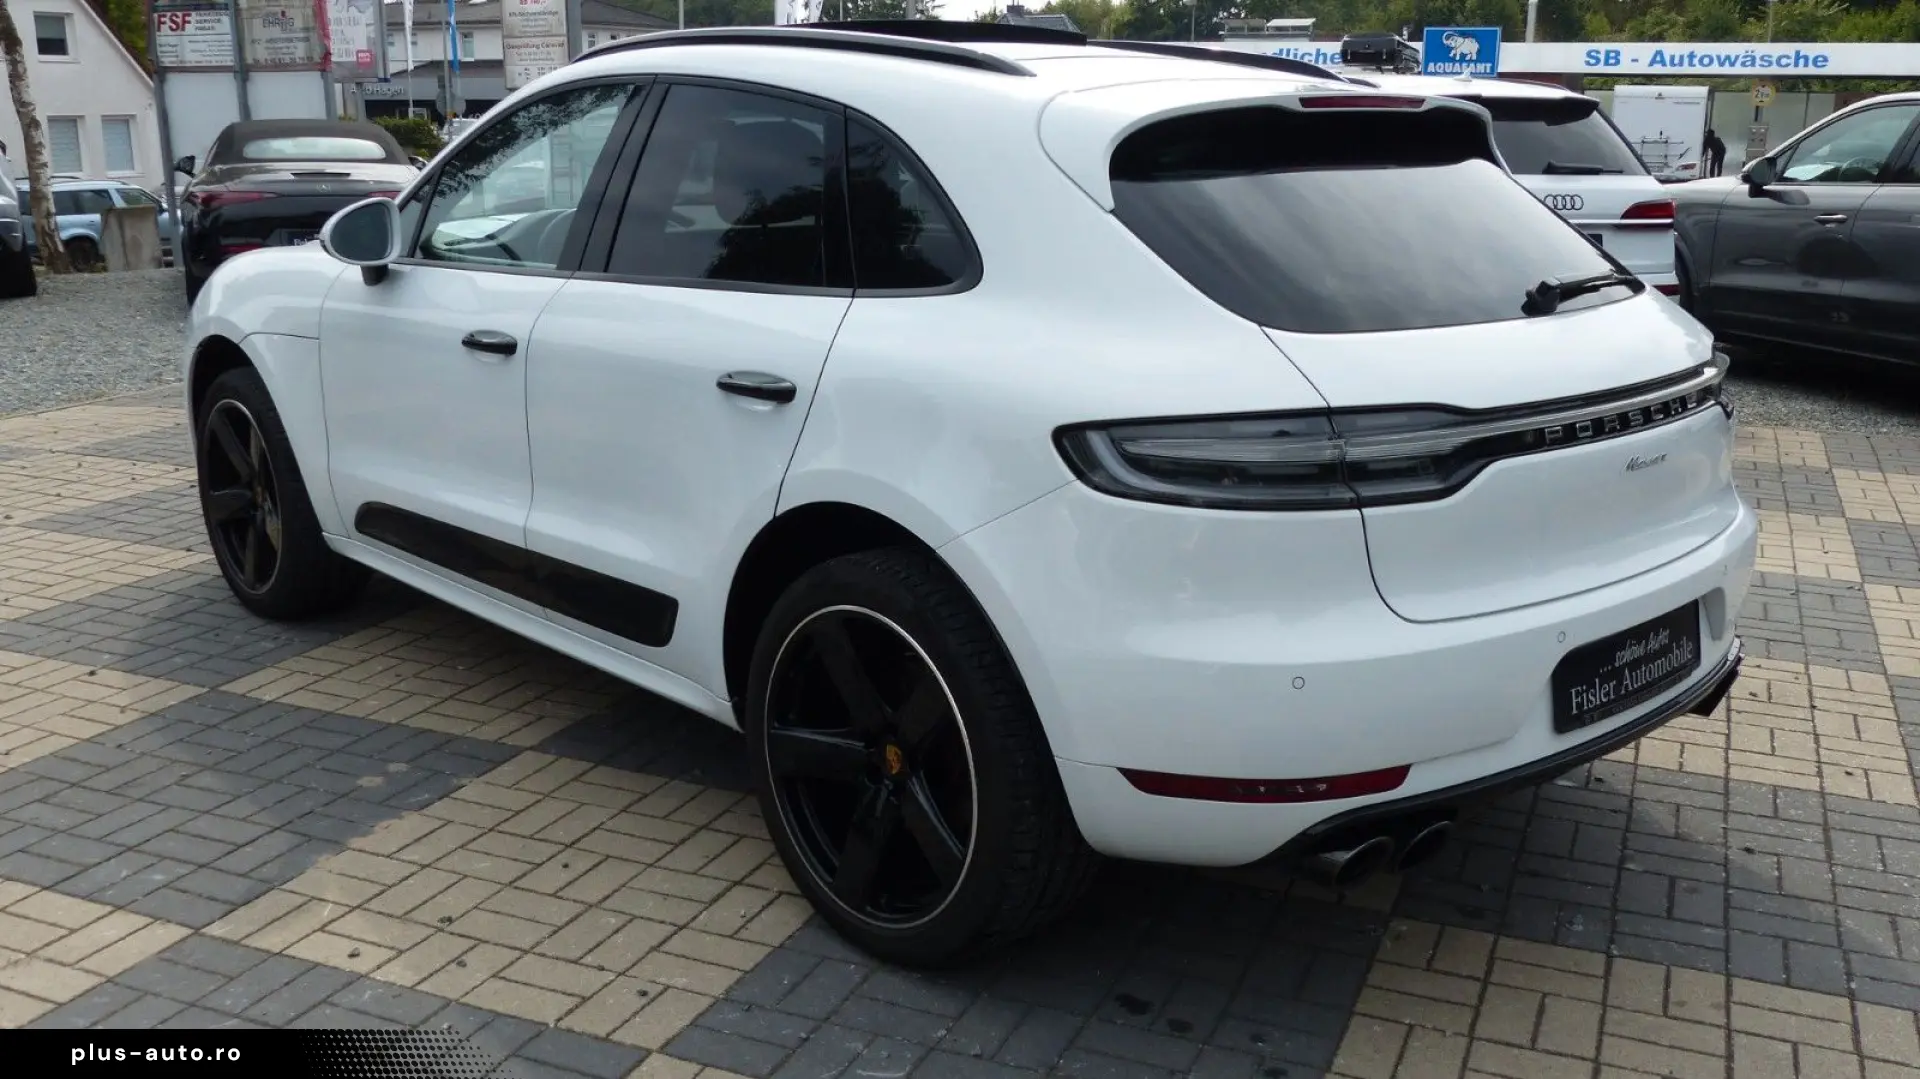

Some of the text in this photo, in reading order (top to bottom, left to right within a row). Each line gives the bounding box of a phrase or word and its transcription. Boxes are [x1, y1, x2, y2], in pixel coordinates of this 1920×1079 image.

[156, 12, 192, 33] FSF
[1584, 49, 1621, 67] SB
[1648, 49, 1829, 68] Autowäsche
[1545, 391, 1699, 445] PORSCHE
[1569, 636, 1694, 715] Fisler Automobile
